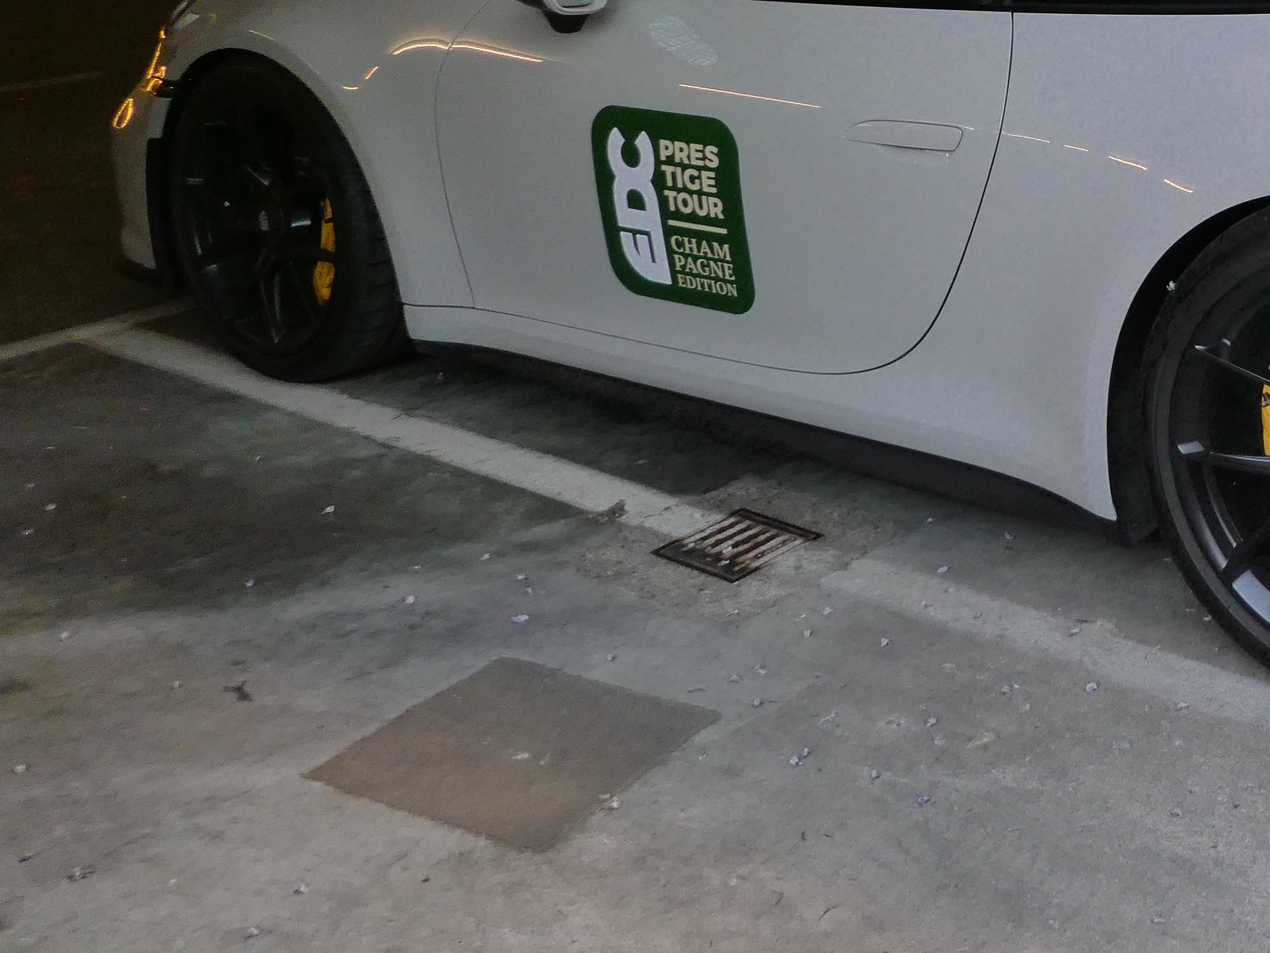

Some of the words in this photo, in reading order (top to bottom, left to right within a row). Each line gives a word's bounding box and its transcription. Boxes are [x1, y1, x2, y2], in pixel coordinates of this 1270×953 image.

[659, 139, 719, 168] PRES
[661, 165, 718, 193] TIGE
[664, 190, 724, 219] TOUR
[670, 235, 732, 261] CHAM
[673, 254, 735, 281] PAGNE
[677, 274, 738, 297] EDITION
